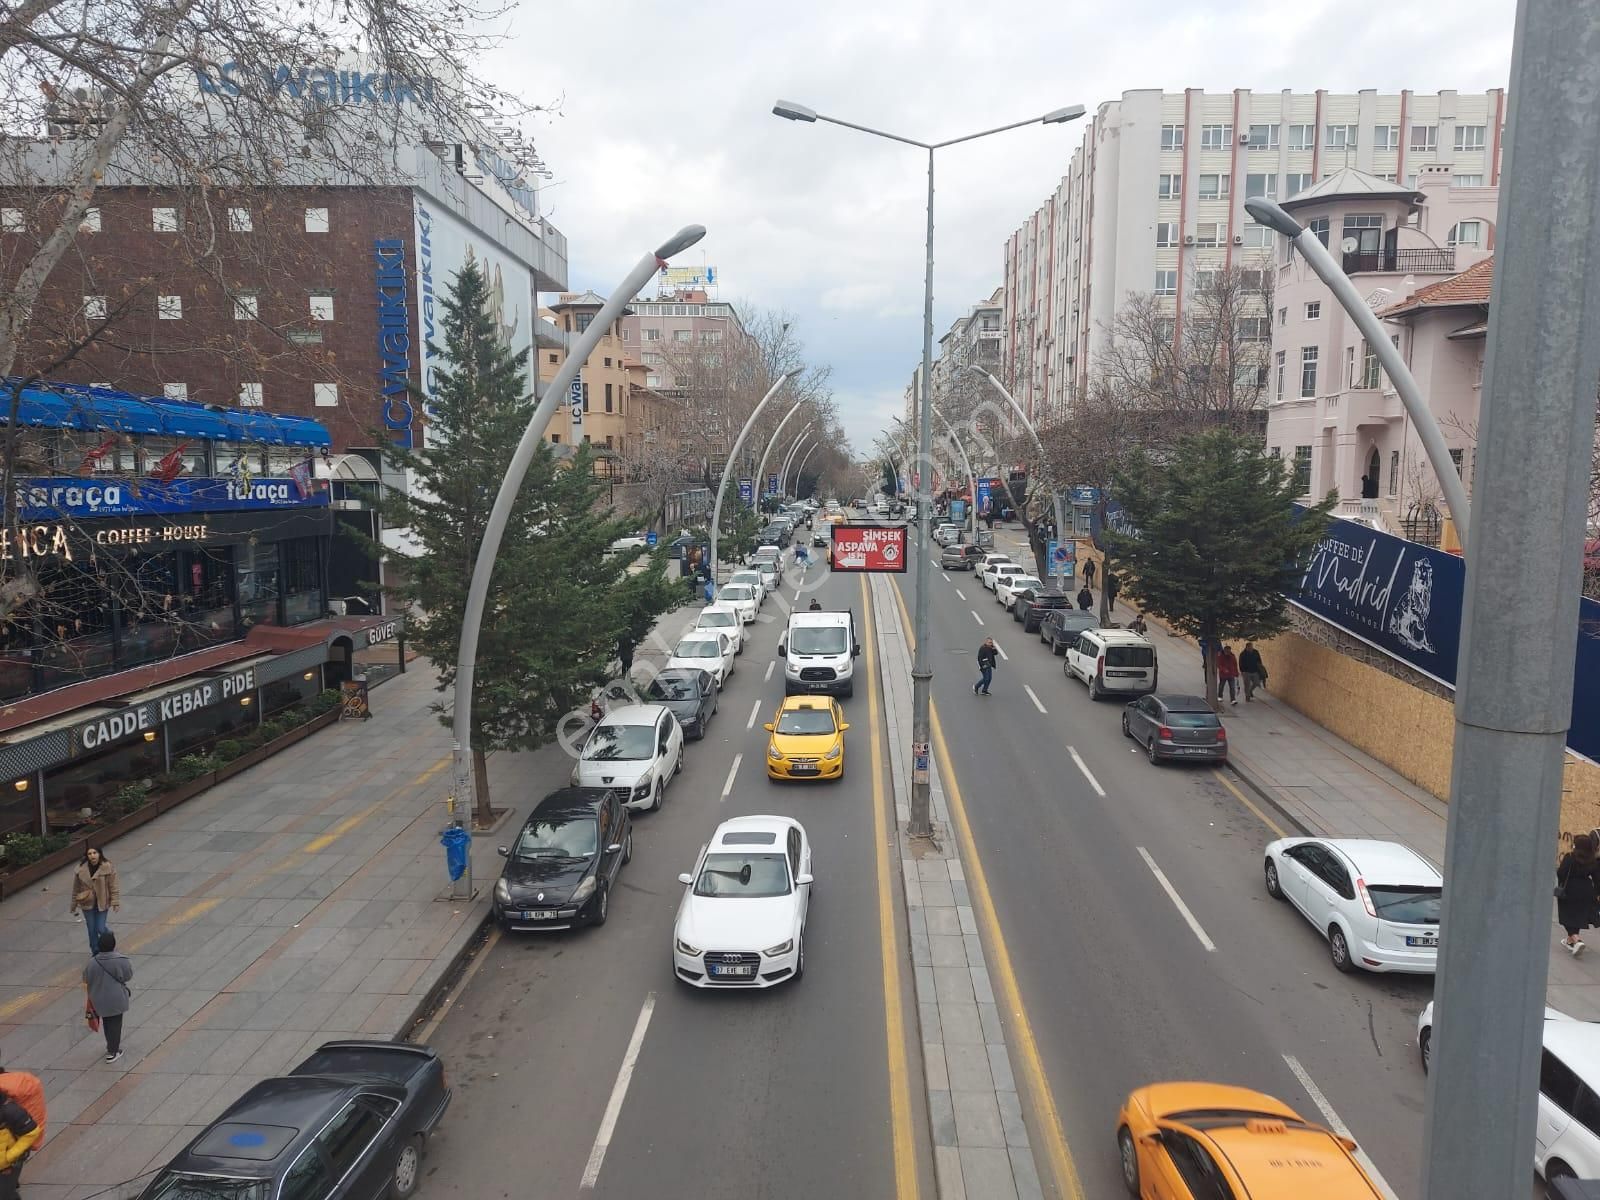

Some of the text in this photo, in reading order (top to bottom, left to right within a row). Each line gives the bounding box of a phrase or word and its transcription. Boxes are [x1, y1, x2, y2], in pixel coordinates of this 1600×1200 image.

[572, 407, 582, 425] LC
[163, 526, 208, 541] HOUSE
[837, 541, 878, 552] ASPAVA
[1300, 538, 1406, 632] Madrid
[82, 706, 149, 749] CADDE
[160, 685, 213, 721] KEBAP
